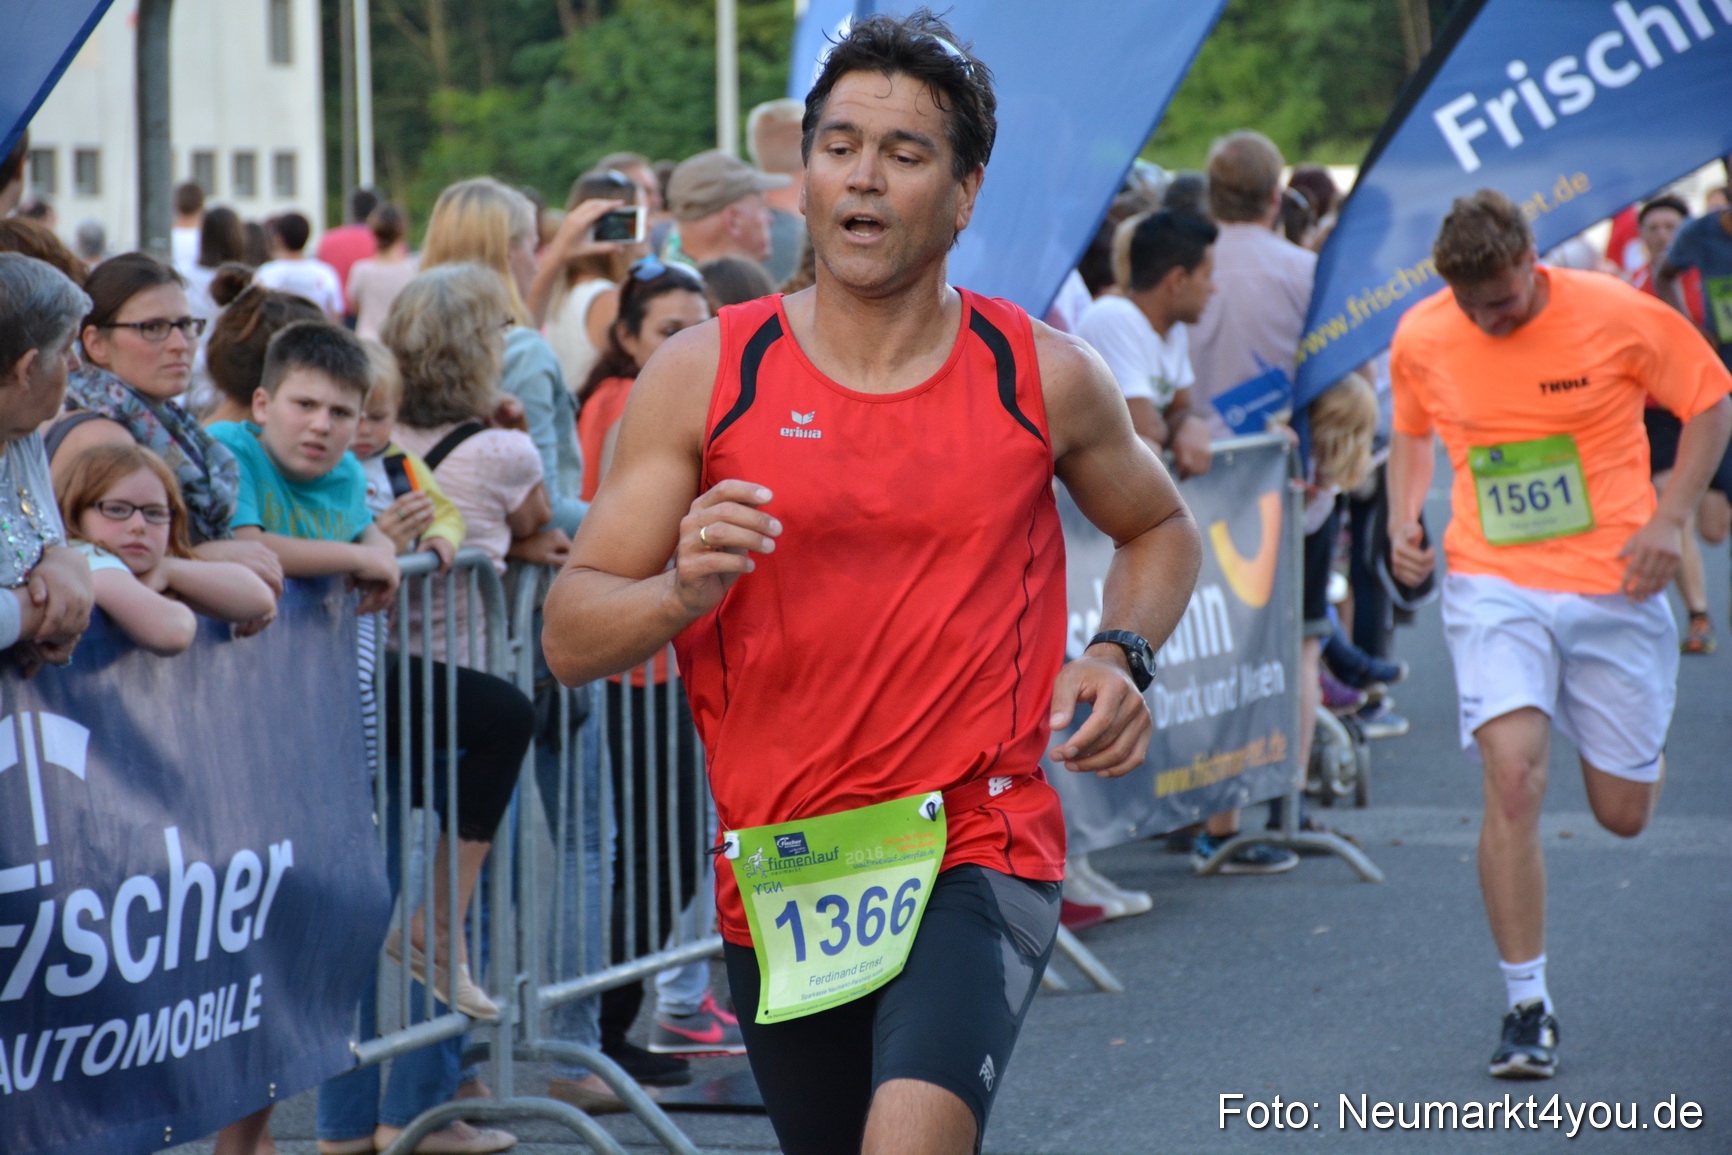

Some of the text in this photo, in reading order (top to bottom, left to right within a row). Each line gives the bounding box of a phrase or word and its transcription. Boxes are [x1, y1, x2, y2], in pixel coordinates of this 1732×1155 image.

[1540, 376, 1589, 395] THULE
[780, 426, 822, 439] erima
[1487, 473, 1573, 517] 1561
[767, 846, 884, 871] firmenlauf 2016
[775, 877, 922, 963] 1366
[808, 965, 858, 987] Ferdinand
[859, 956, 884, 973] Ernst
